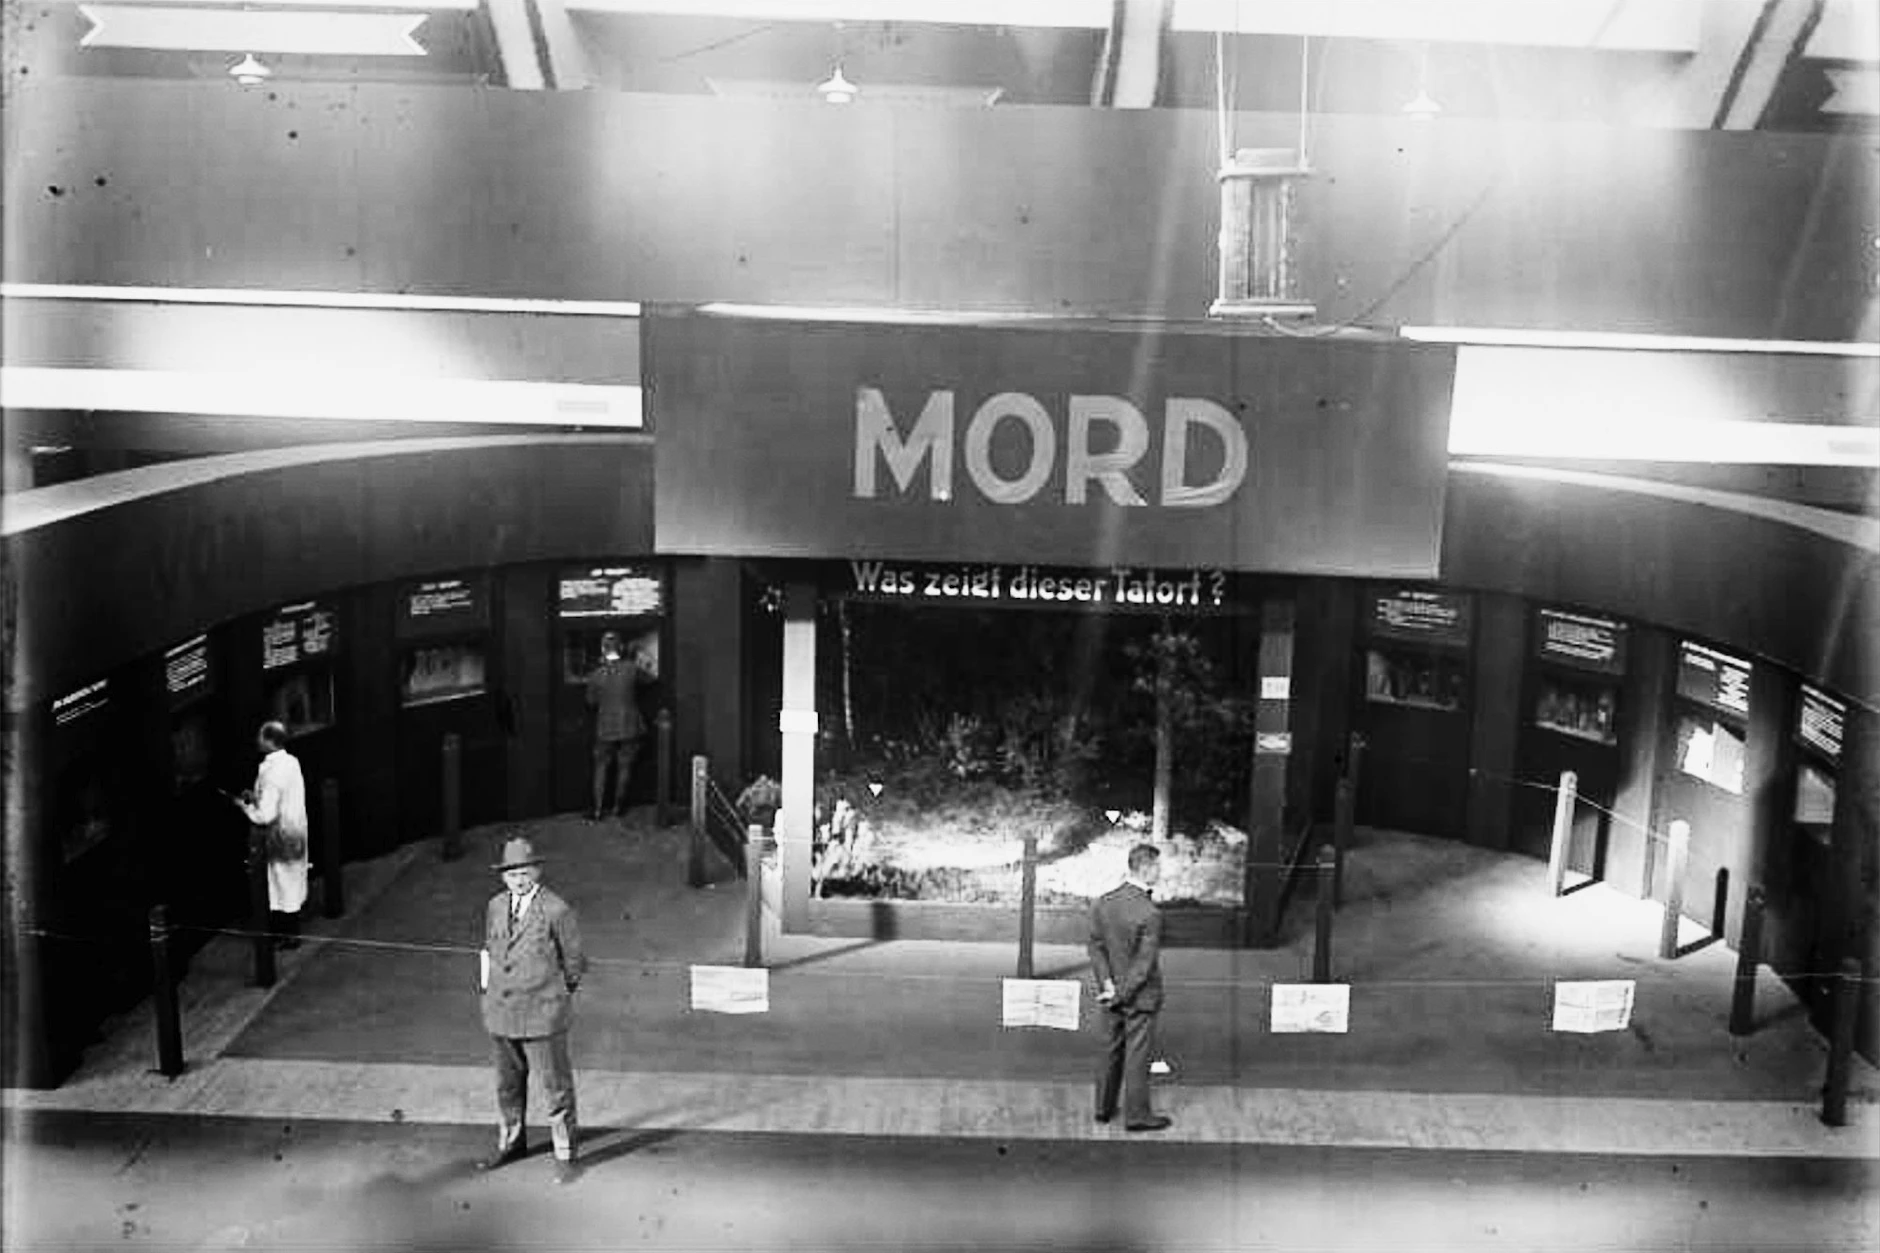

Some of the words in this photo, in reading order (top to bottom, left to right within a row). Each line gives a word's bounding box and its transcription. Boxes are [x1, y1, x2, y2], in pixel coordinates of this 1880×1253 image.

[854, 387, 1248, 507] MORD
[851, 561, 914, 594] Was
[924, 566, 1001, 599] zeigt
[1010, 566, 1106, 602] dieser
[1111, 568, 1202, 605] Tatort
[1210, 569, 1226, 606] ?
